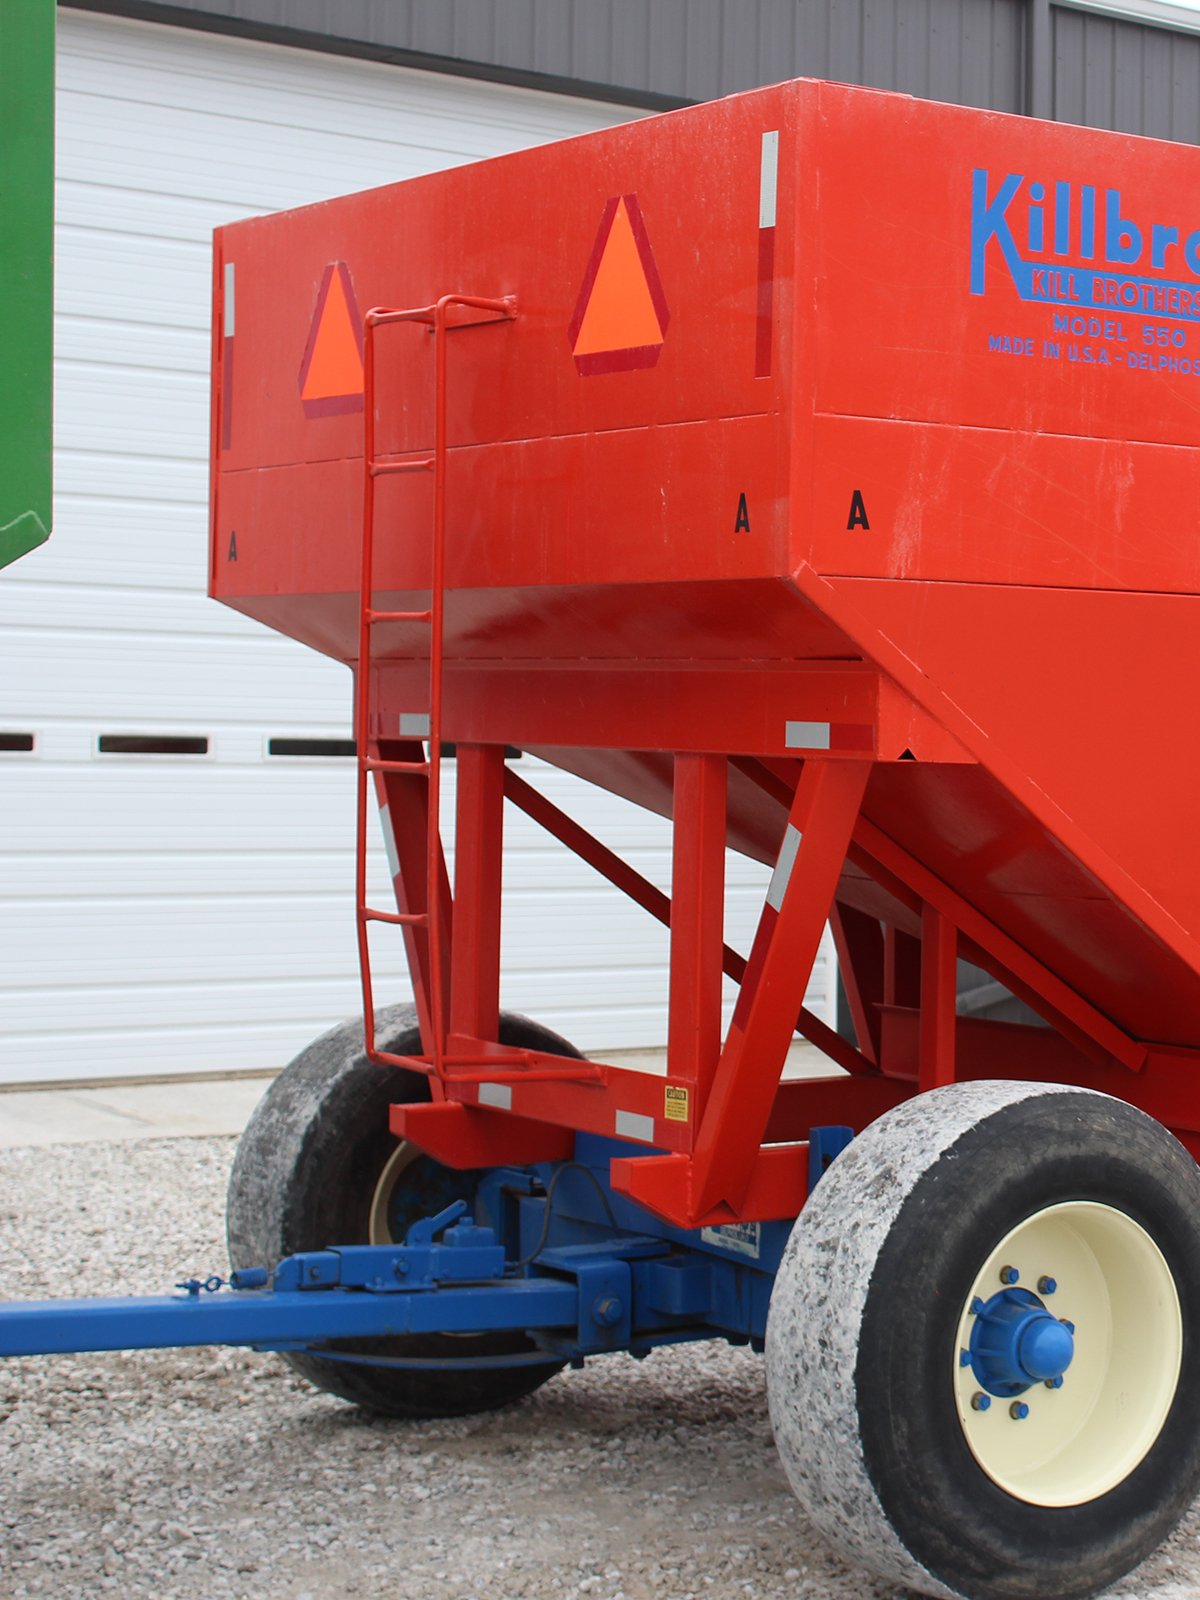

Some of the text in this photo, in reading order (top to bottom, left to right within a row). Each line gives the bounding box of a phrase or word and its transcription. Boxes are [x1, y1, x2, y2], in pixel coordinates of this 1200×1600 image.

[1032, 269, 1079, 301] KILL
[988, 334, 1034, 357] MADE
[1043, 340, 1060, 360] IN
[1053, 312, 1187, 348] MODEL 550
[735, 492, 750, 533] A
[847, 490, 870, 530] A
[228, 529, 237, 562] A
